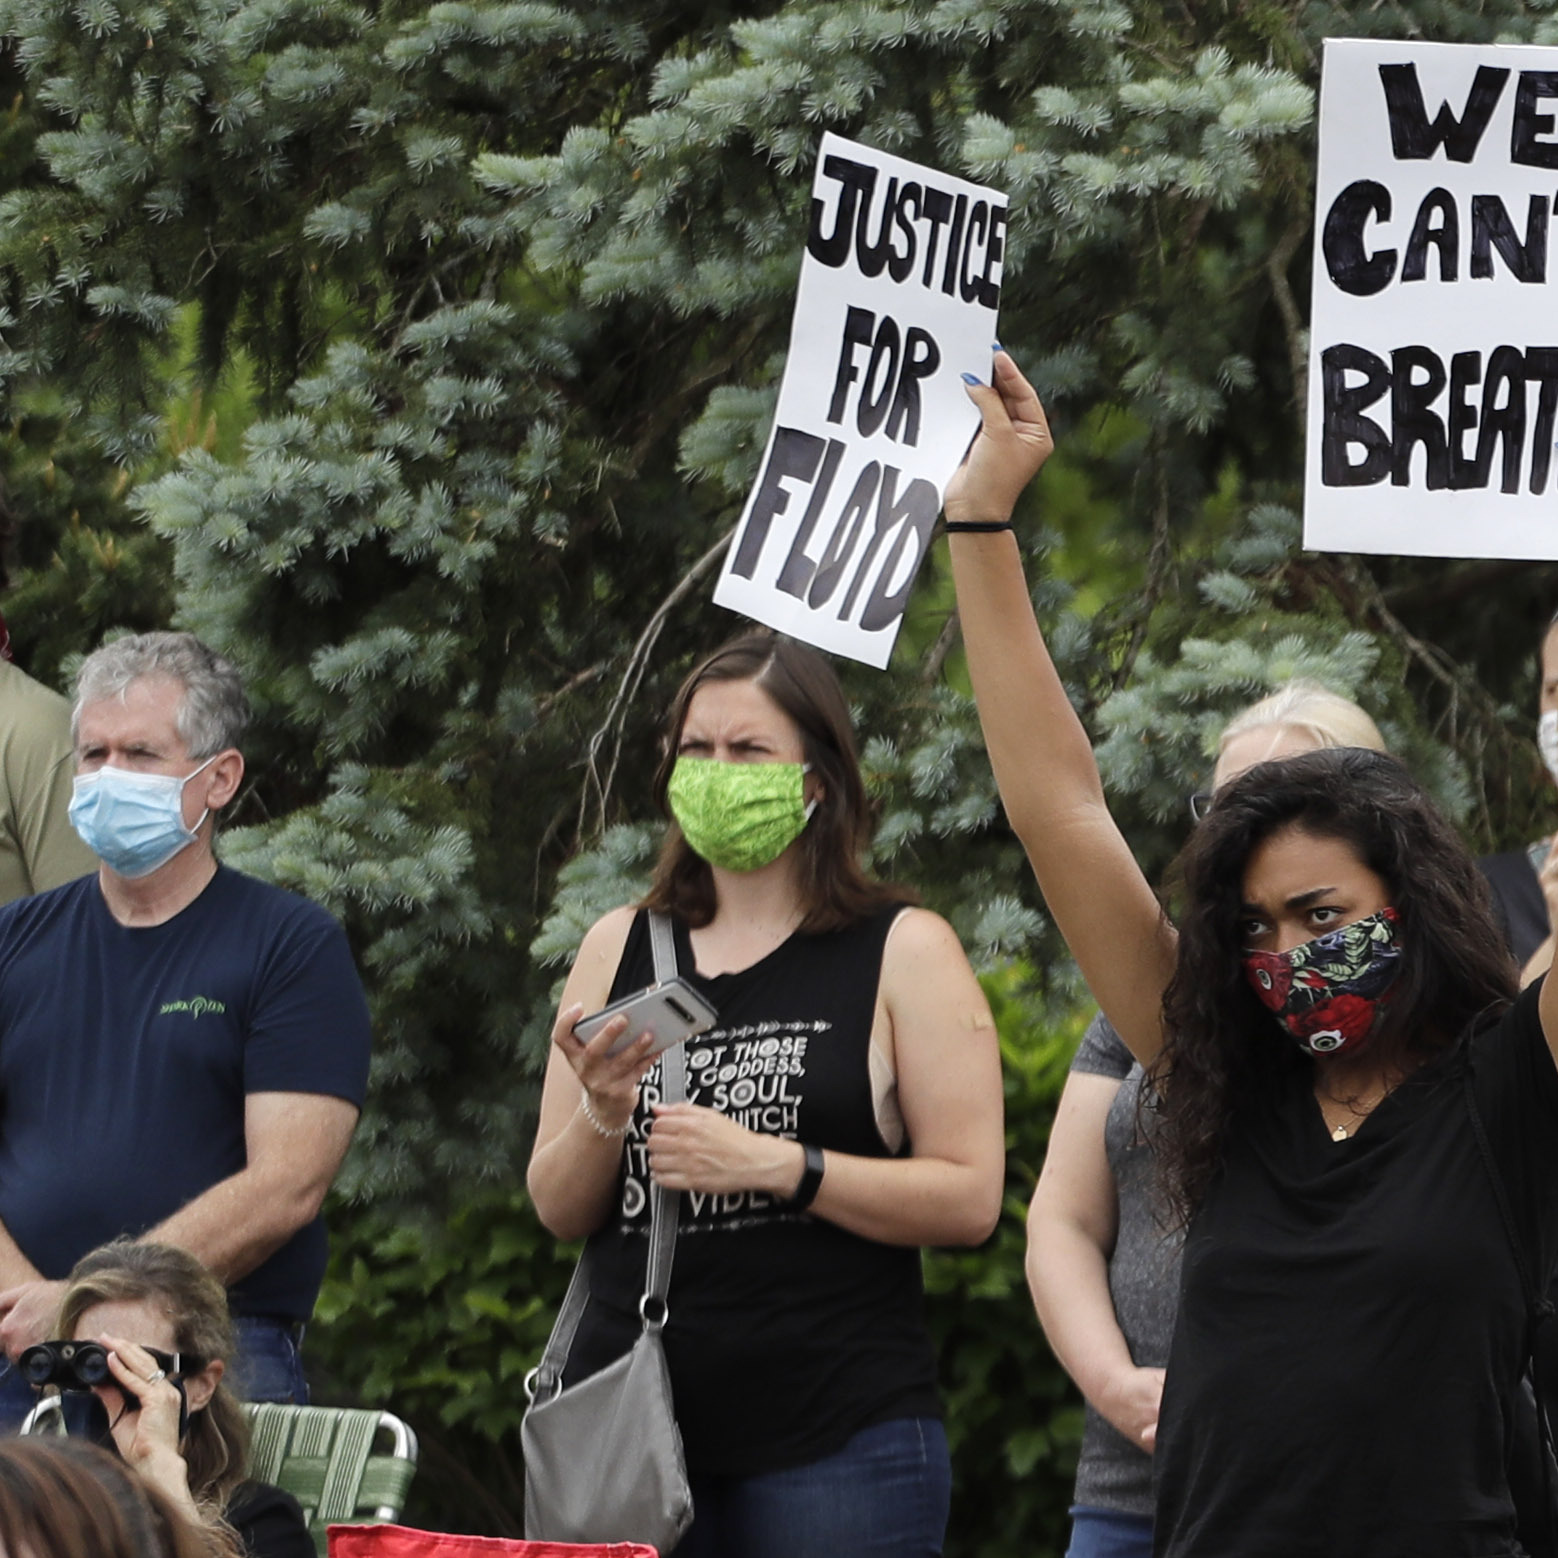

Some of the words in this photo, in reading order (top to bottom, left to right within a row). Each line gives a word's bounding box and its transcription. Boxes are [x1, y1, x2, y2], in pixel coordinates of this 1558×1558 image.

[806, 156, 1006, 310] JUSTICE
[825, 304, 941, 447] FOR
[730, 426, 941, 633] FLOYD
[700, 1055, 807, 1087] GODDESS,
[712, 1074, 804, 1112] SOUL,
[734, 1036, 809, 1064] THOSE
